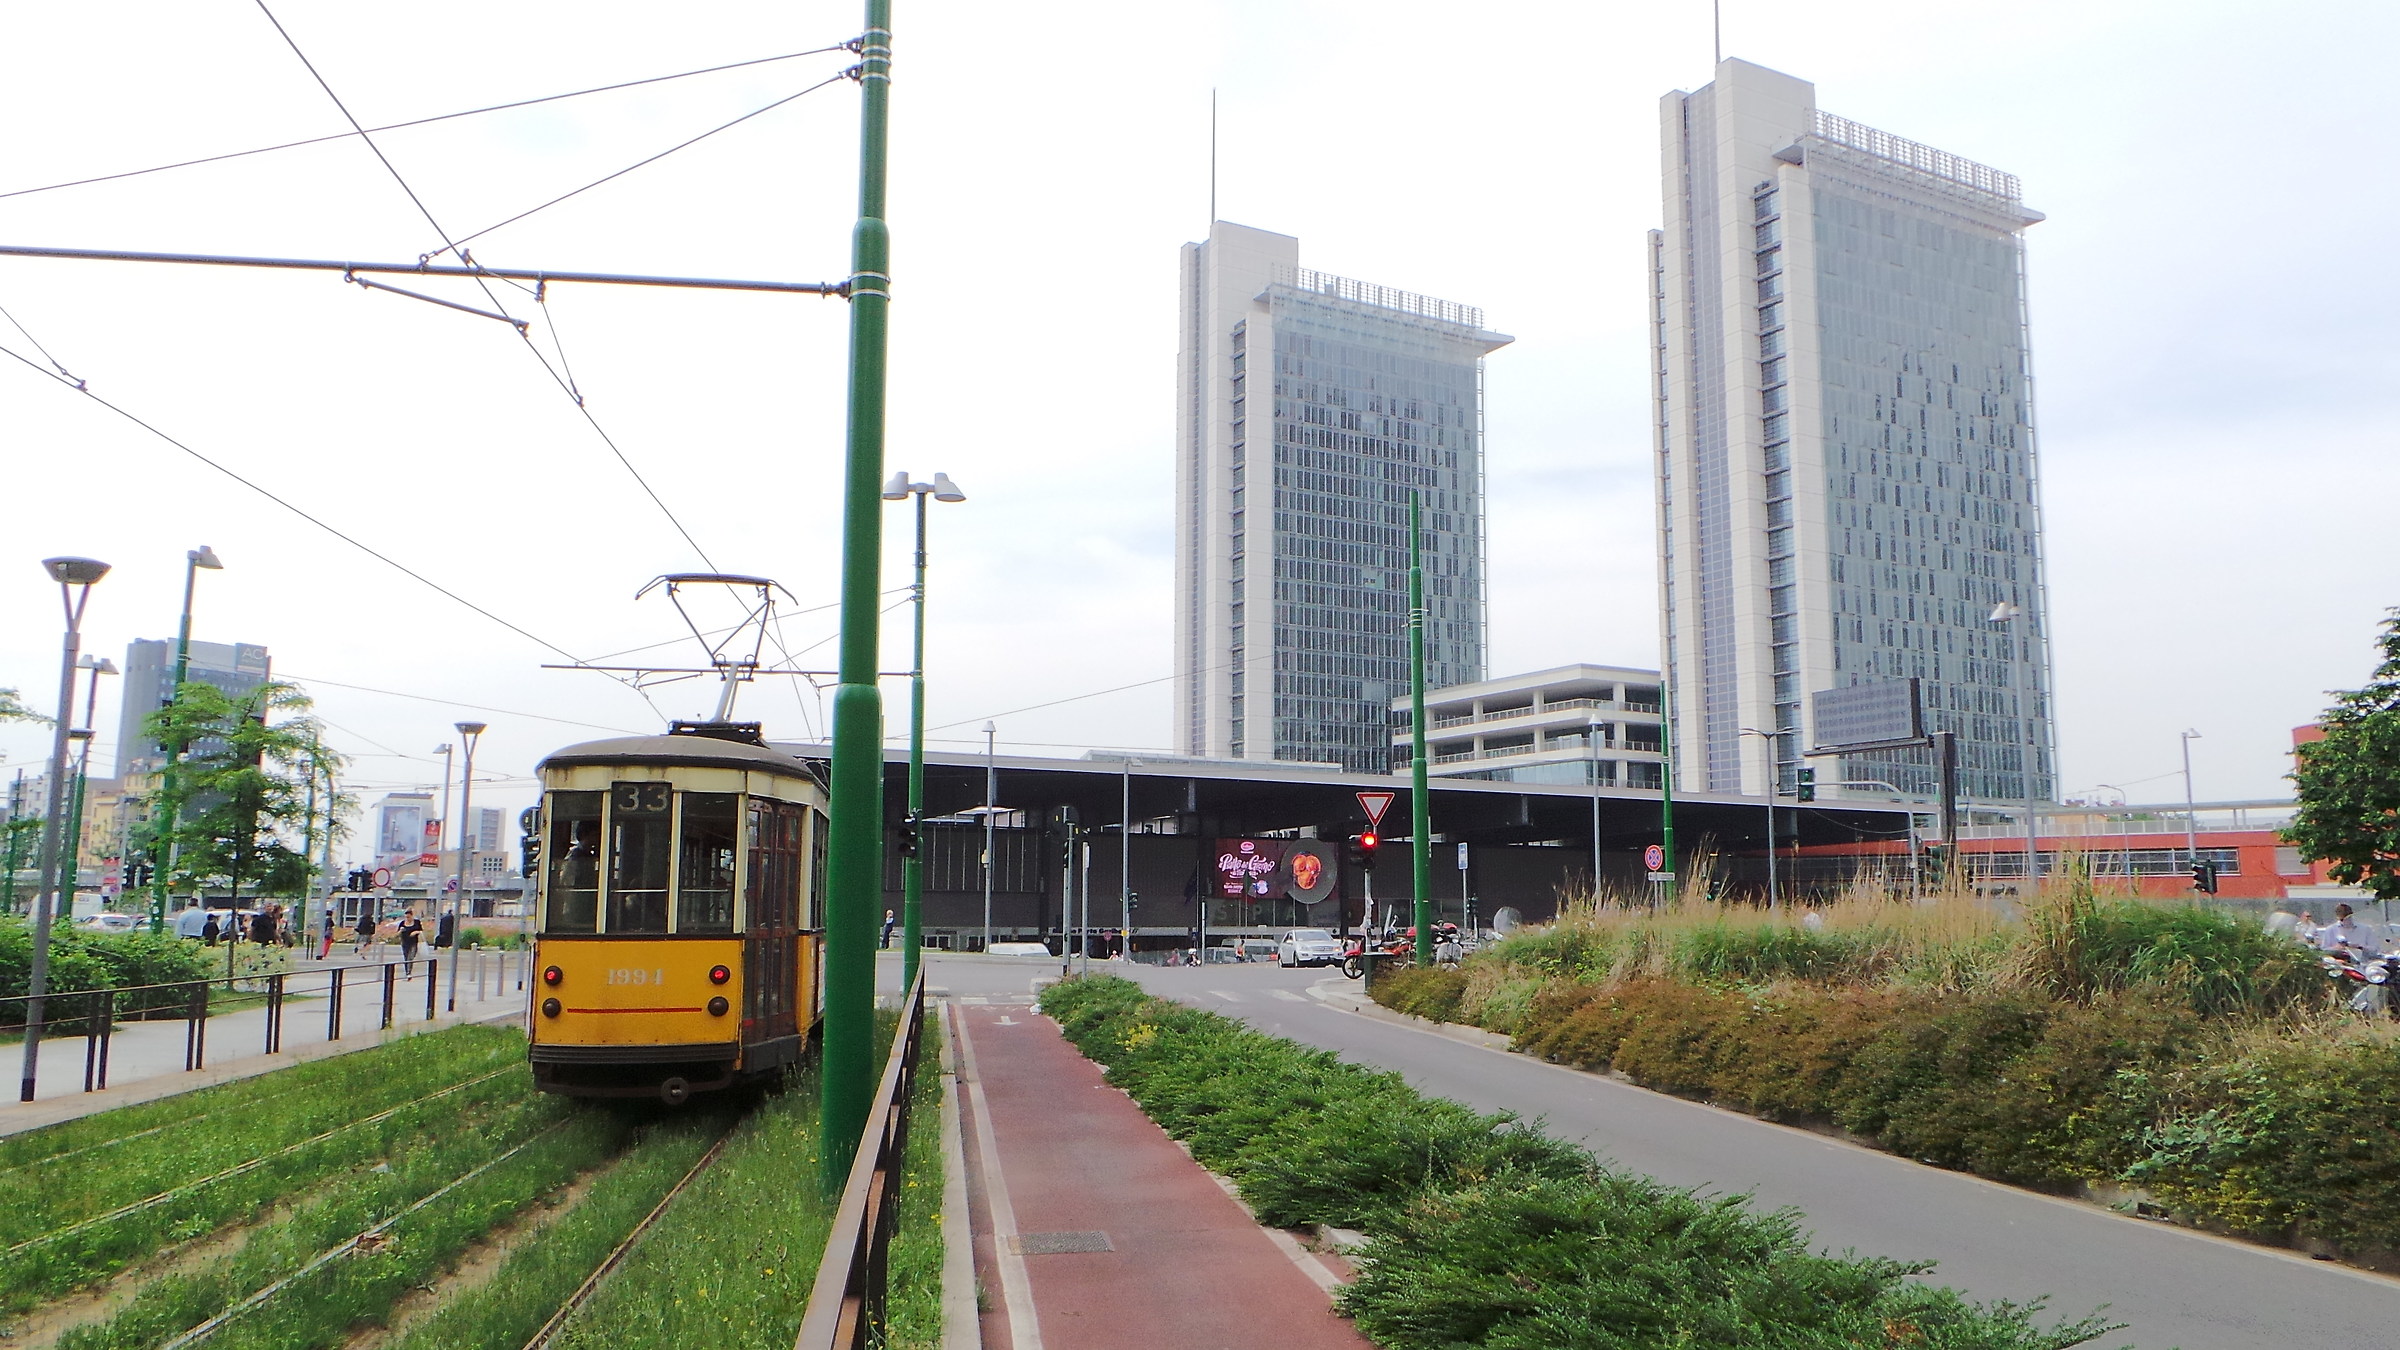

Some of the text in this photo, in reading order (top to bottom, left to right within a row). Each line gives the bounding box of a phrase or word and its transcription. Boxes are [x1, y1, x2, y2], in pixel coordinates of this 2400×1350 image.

[242, 648, 265, 660] AC
[618, 785, 668, 812] 33
[608, 968, 664, 985] 1994
